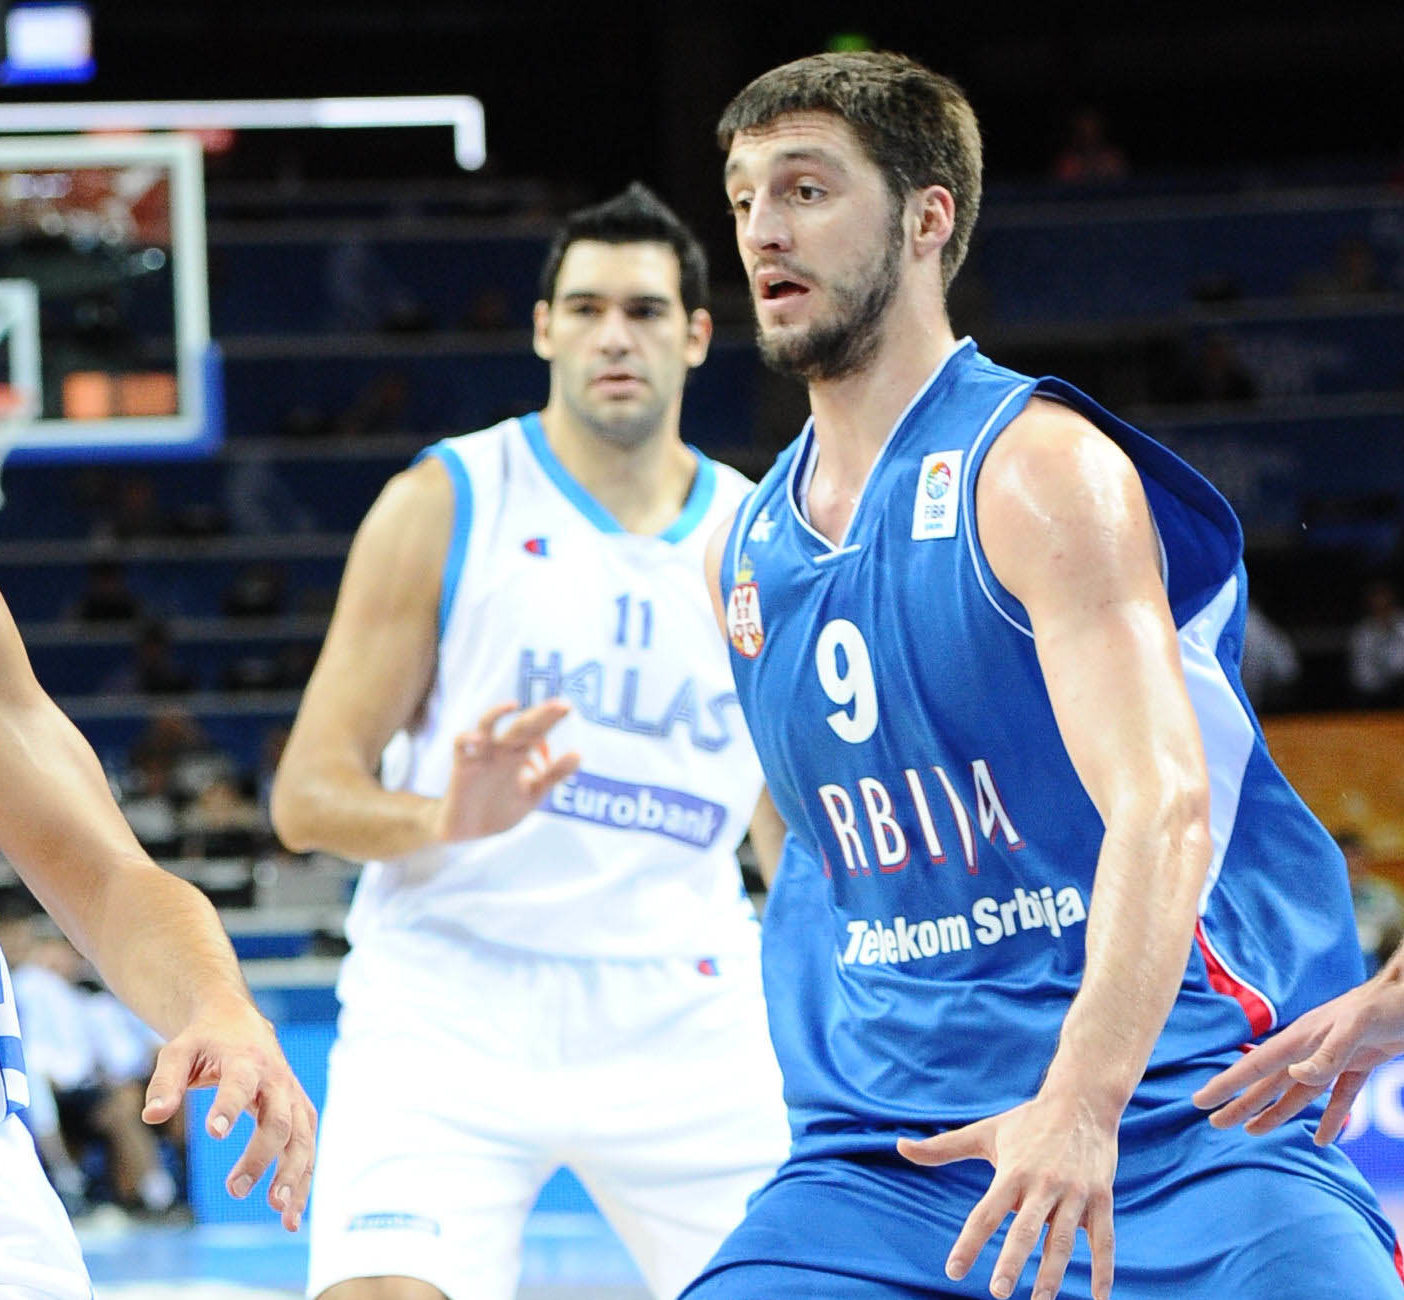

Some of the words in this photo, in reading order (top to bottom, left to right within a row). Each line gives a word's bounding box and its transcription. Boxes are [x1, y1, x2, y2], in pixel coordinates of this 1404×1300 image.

[615, 593, 654, 648] 11
[815, 618, 879, 744] 9
[552, 783, 716, 844] Eurobank
[820, 759, 1026, 876] RBIJA
[842, 913, 971, 966] Telekom
[971, 886, 1086, 944] Srbija
